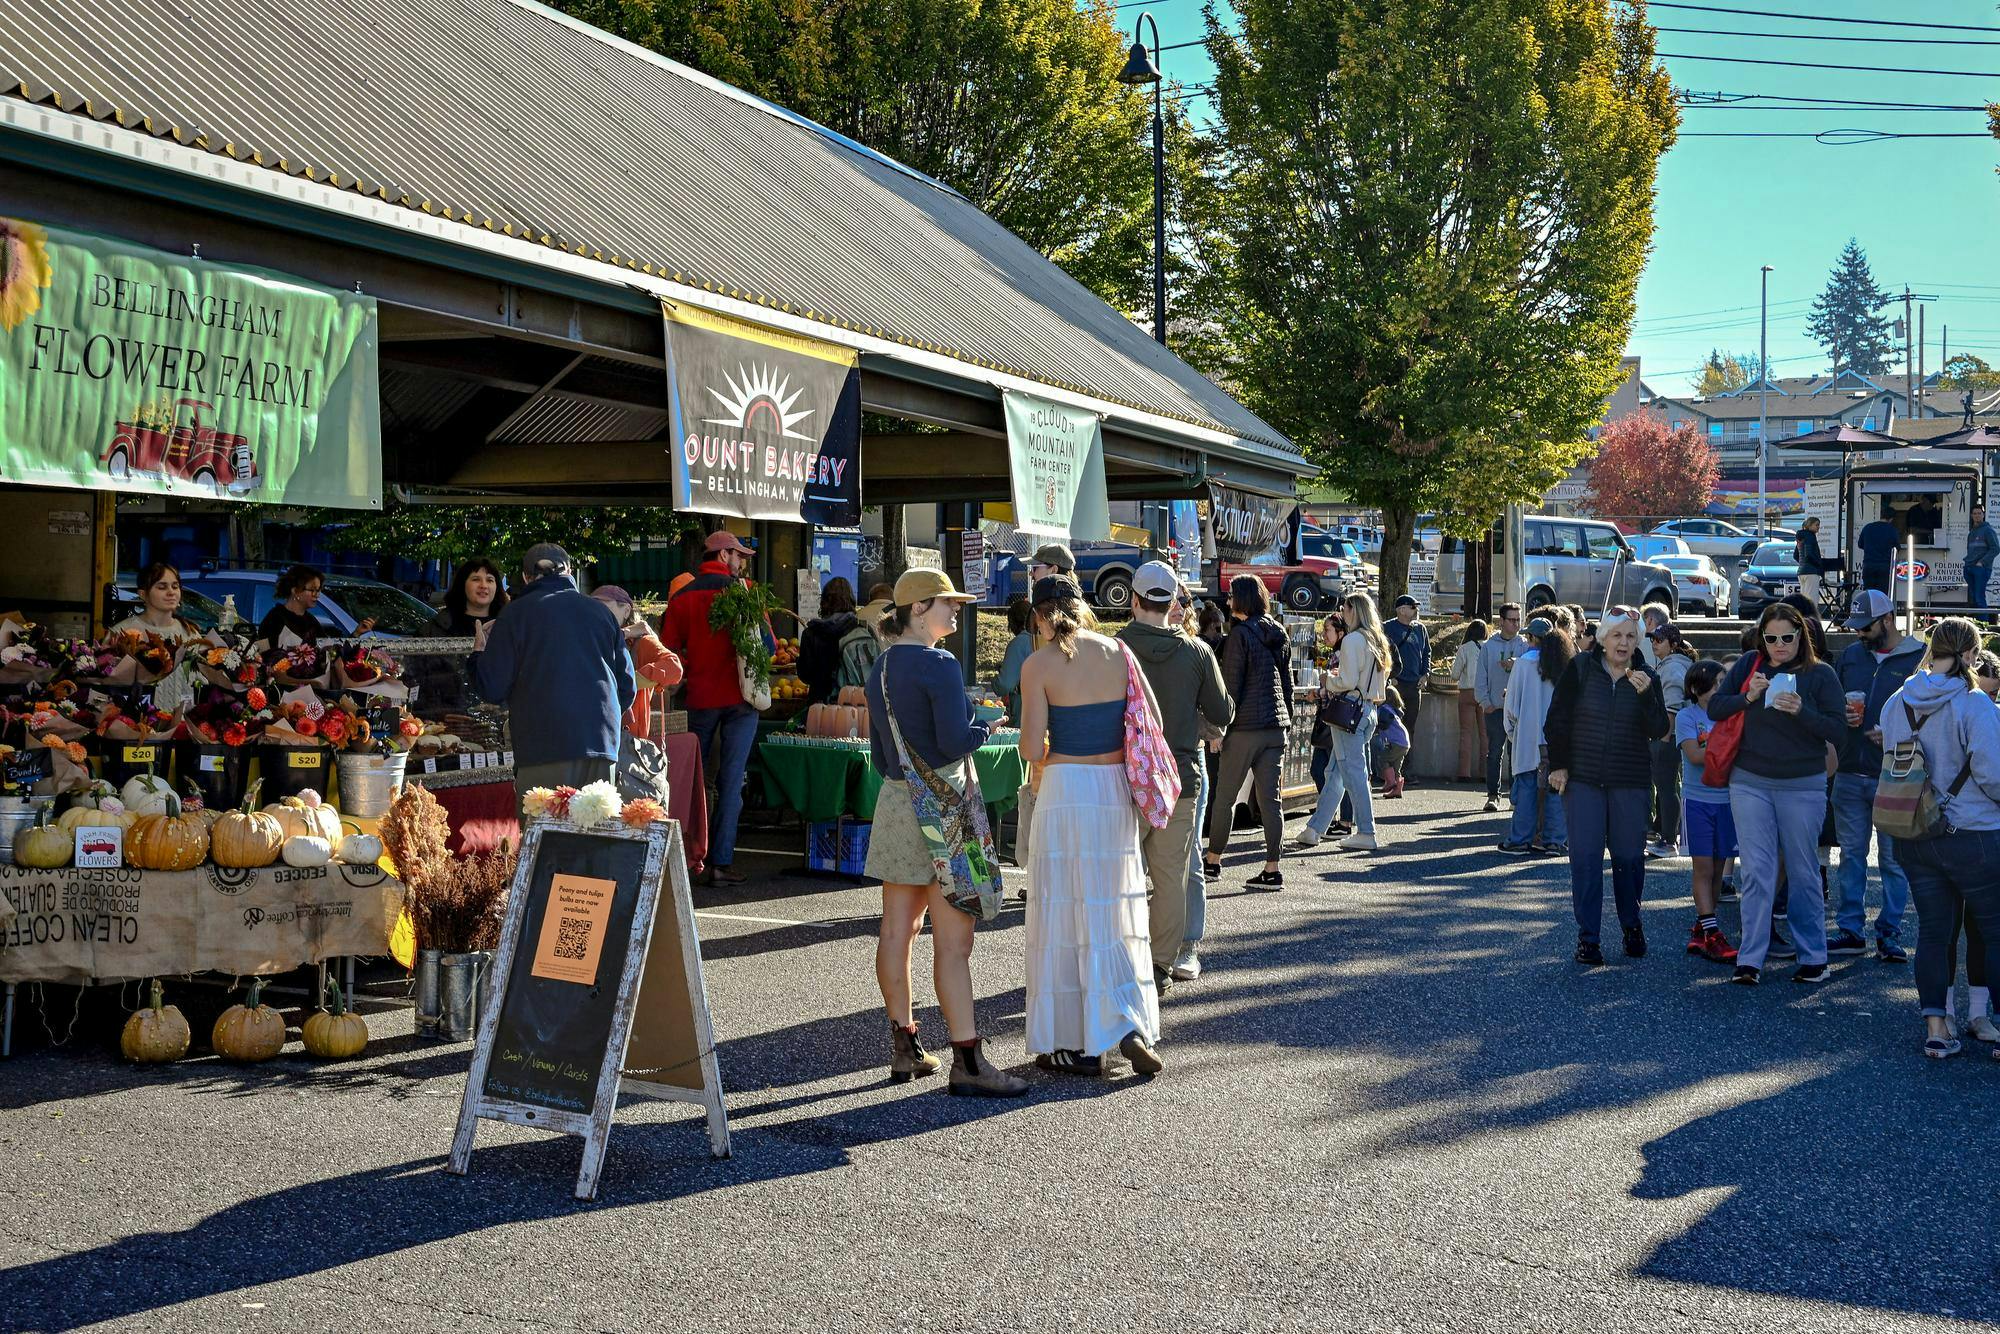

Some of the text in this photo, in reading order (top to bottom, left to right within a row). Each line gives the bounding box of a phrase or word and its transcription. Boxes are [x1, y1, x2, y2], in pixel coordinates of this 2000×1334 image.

[93, 274, 282, 338] BELLINGHAM
[29, 324, 313, 408] FLOWER FARM
[1028, 432, 1075, 459] MOUNTAIN
[684, 433, 847, 487] OUNT BAKERY
[1030, 456, 1072, 475] FARM CENTER
[708, 476, 789, 502] BELLINGHAM,
[131, 751, 151, 759] $20
[298, 756, 317, 765] $20
[78, 856, 119, 866] FLOWERS
[274, 865, 327, 883] FECCEG
[351, 864, 379, 876] USDA
[62, 882, 140, 898] PRODUCT OF
[559, 885, 604, 899] Peony and tulips
[62, 897, 139, 913] PRODUCTO DE
[559, 895, 574, 903] bulbs
[563, 906, 590, 915] available
[72, 914, 138, 944] CLEAN
[563, 1063, 589, 1081] Cards
